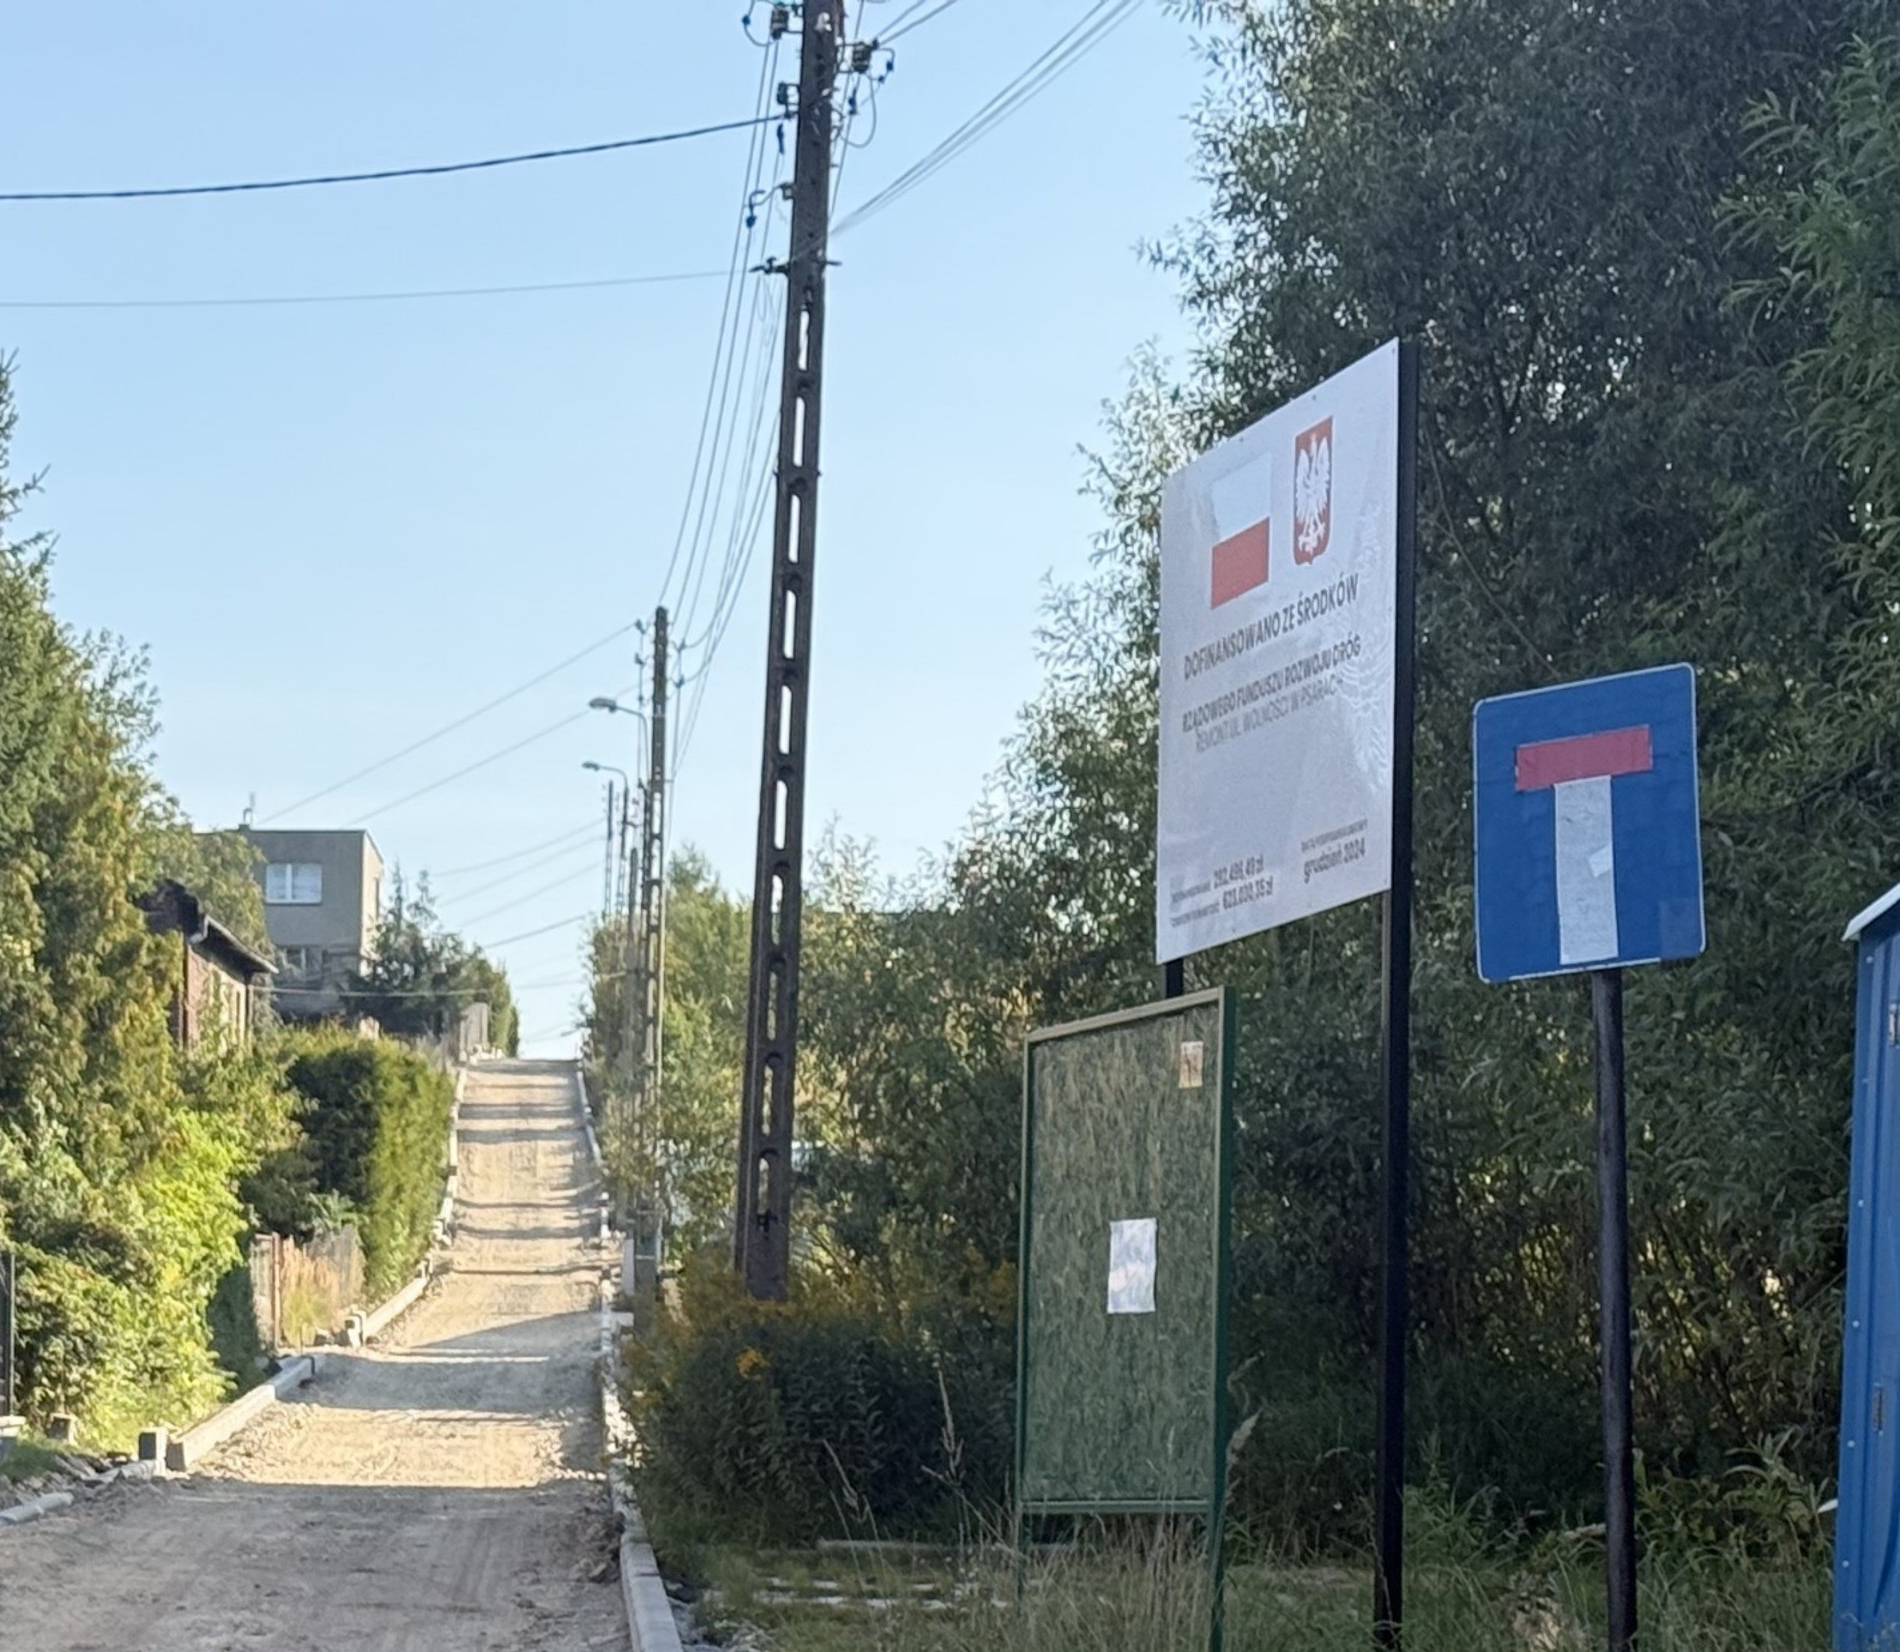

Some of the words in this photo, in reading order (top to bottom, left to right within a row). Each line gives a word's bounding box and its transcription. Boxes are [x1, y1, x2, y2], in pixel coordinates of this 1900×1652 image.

[1184, 609, 1279, 681] DOFINANSOWANO
[1282, 602, 1294, 634] ZE
[1297, 571, 1359, 626] ŚRODKÓW
[1284, 647, 1330, 687] ROZWOJU
[1332, 627, 1360, 666] DRÓG
